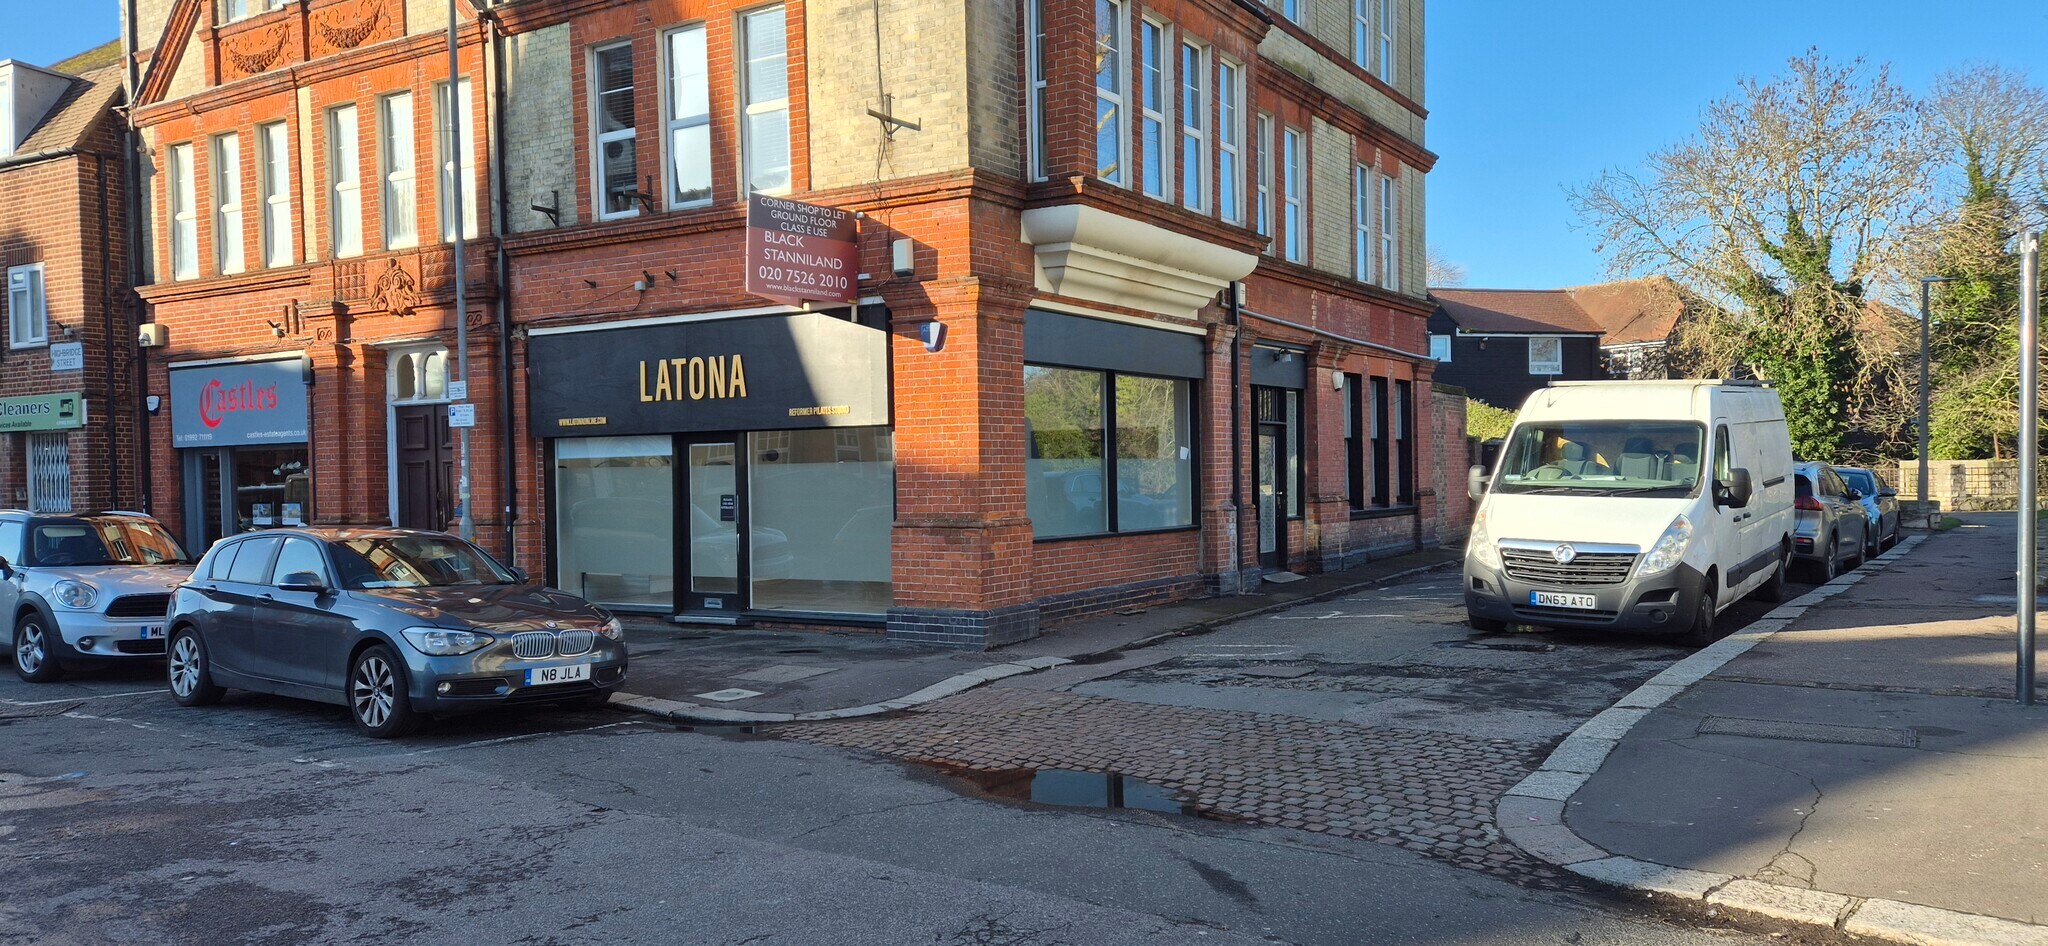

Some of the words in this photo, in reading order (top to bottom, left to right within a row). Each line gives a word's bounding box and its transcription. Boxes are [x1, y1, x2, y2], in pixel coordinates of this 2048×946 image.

[760, 197, 796, 211] CORNER
[797, 203, 819, 215] SHOP
[820, 209, 832, 217] TO
[833, 210, 847, 220] LET
[770, 209, 808, 224] GROUND
[809, 216, 837, 228] FLOOR
[780, 222, 805, 234] CLASS
[806, 226, 812, 234] E
[813, 229, 828, 237] USE
[764, 230, 804, 248] BLACK
[764, 248, 843, 270] STANNILAND
[759, 265, 782, 281] 020
[786, 269, 816, 285] 7526
[819, 274, 848, 289] 2010
[765, 283, 842, 298] www.blackstanniland.com
[56, 358, 76, 367] STREET
[639, 354, 747, 402] LATONA
[199, 378, 278, 429] Castles
[788, 406, 813, 417] REFORMER
[813, 406, 832, 416] PILATES
[1538, 593, 1567, 605] DN63
[1570, 596, 1593, 607] ATO
[151, 627, 165, 636] ML
[541, 668, 557, 681] N8
[560, 666, 581, 680] JLA
